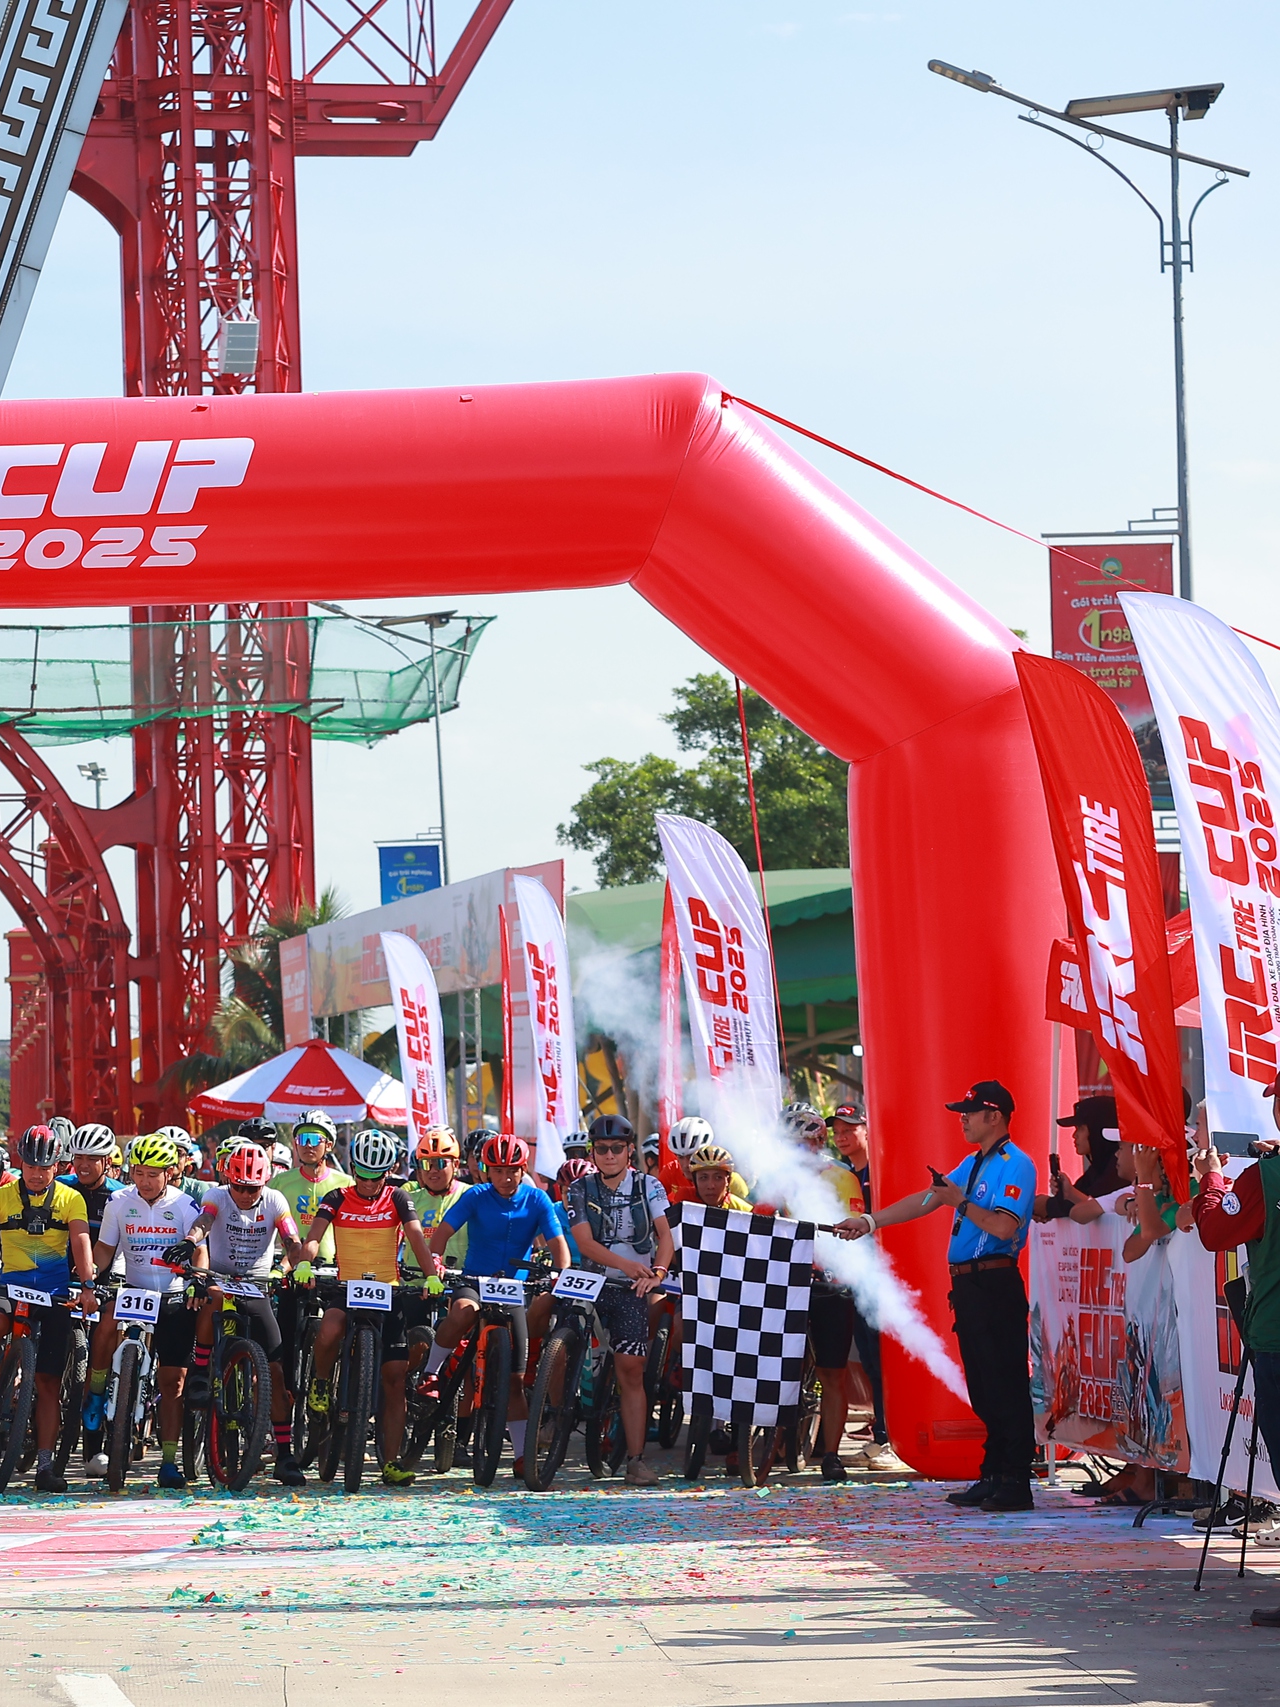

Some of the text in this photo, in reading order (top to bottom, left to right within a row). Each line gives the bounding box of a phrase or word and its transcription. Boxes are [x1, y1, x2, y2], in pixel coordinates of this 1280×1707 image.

[1084, 608, 1133, 648] 1 ngà
[1178, 715, 1250, 885] CUP
[1079, 795, 1125, 881] TIRE
[1230, 896, 1261, 953] TIRE
[688, 897, 728, 1007] CUP
[724, 925, 749, 1015] 2025
[400, 987, 423, 1061] CUP
[418, 1004, 432, 1066] 2025
[713, 1013, 732, 1049] TIRE
[137, 1226, 178, 1234] MAXXIS
[340, 1211, 393, 1222] TREK
[14, 1289, 46, 1303] 364
[353, 1286, 386, 1300] 349
[486, 1283, 518, 1296] 342
[563, 1276, 597, 1290] 357
[121, 1296, 154, 1312] 316
[1079, 1312, 1126, 1381] CUP
[1079, 1380, 1112, 1421] 2025
